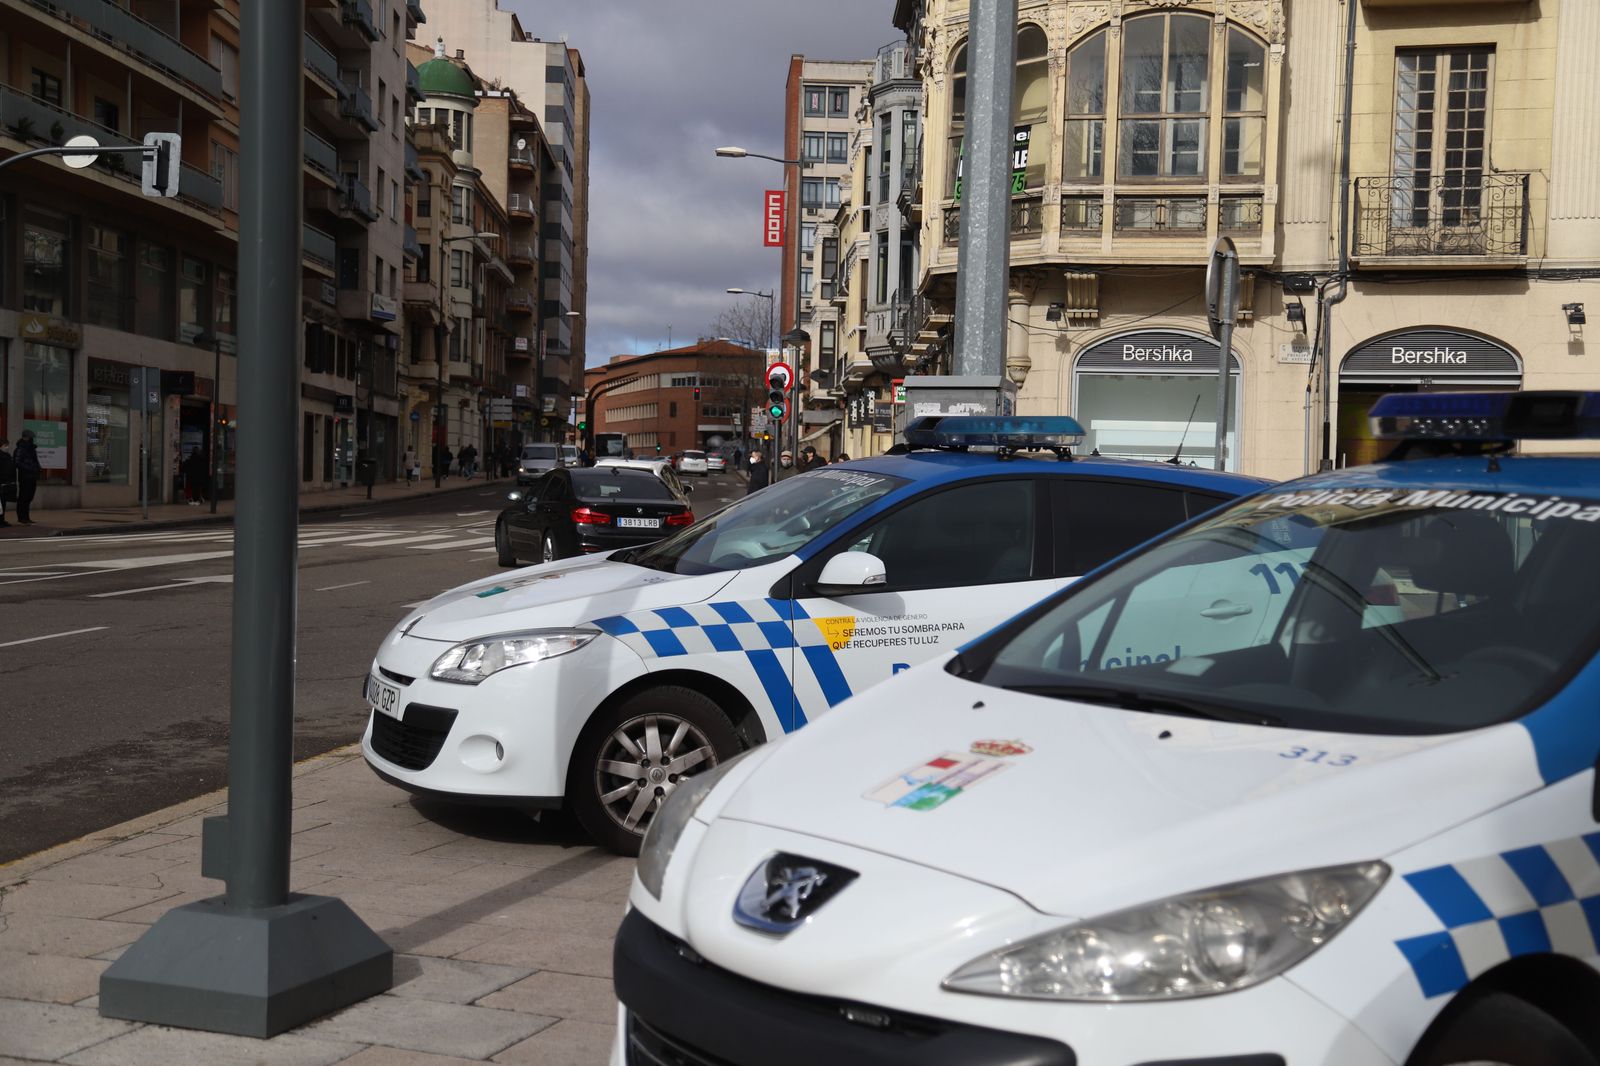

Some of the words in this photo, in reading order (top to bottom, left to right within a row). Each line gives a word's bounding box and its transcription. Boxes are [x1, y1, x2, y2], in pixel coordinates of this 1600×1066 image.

[768, 194, 781, 243] CCOO
[1123, 344, 1193, 362] Bershka
[1391, 347, 1467, 364] Bershka
[1258, 489, 1393, 509] Policía
[623, 518, 642, 526] 3813
[643, 519, 658, 527] LRB
[842, 626, 887, 637] SEREMOS
[888, 626, 901, 635] TU
[901, 623, 940, 634] SOMBRA
[941, 622, 965, 631] PARA
[832, 640, 852, 650] QUE
[853, 637, 907, 648] RECUPERES
[908, 636, 920, 645] TU
[921, 635, 939, 644] LUZ
[381, 687, 396, 712] GZP
[1278, 744, 1358, 769] 313
